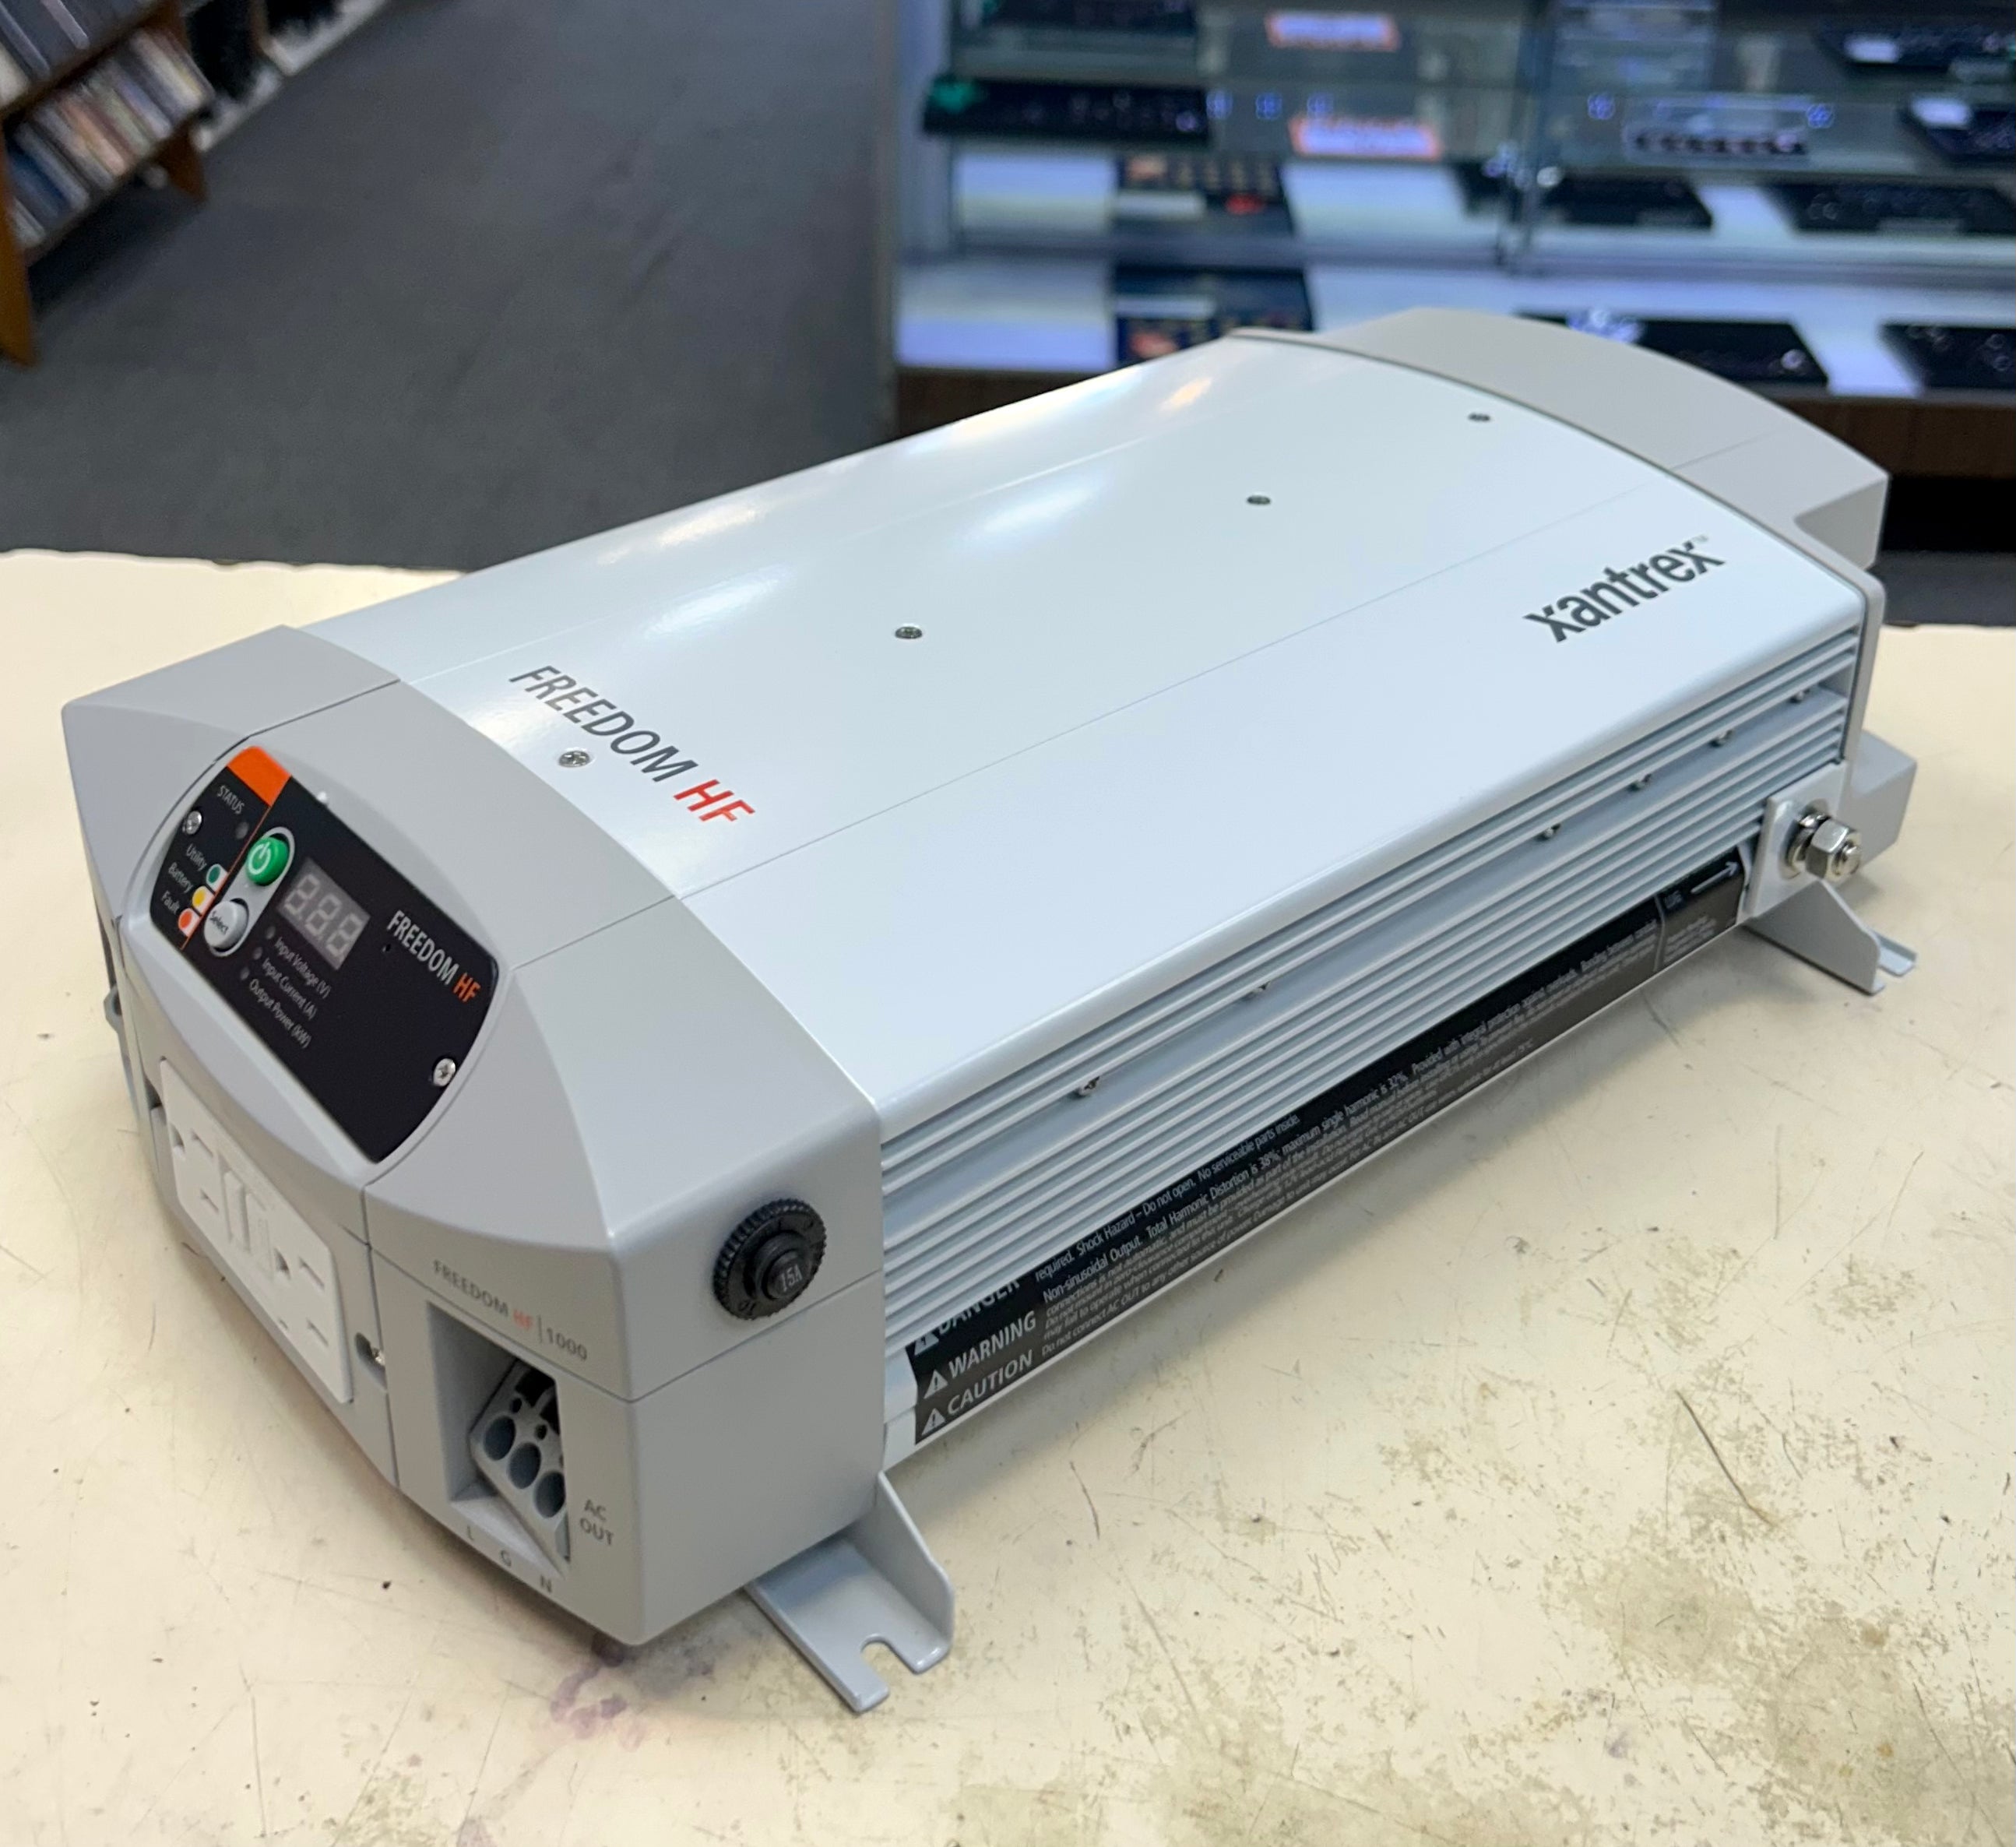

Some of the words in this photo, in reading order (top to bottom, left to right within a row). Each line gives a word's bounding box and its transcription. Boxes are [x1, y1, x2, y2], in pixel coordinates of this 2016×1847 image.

[1522, 540, 1726, 643] xantrex
[508, 665, 698, 783] FREEDOM
[672, 779, 755, 822] HF
[217, 785, 245, 814] STATUS
[167, 862, 194, 893] Battery
[186, 843, 207, 871] Utility
[160, 890, 181, 915] Fault
[209, 909, 229, 935] Select
[275, 937, 295, 962] Input
[293, 953, 319, 987] Voltage
[315, 980, 332, 1000] (V)
[386, 909, 460, 985] FREEDOM
[452, 972, 481, 1003] HF
[249, 978, 275, 1009] Output
[273, 1001, 294, 1031] Power
[262, 957, 282, 983] Input
[279, 975, 307, 1009] Current
[303, 1001, 318, 1022] (A)
[1043, 1252, 1107, 1303] Non-sinusoidal
[1110, 1233, 1142, 1263] Output.
[1146, 1216, 1167, 1240] Total
[1168, 1193, 1209, 1226] Harmonic
[1209, 1170, 1248, 1201] Distortion
[1250, 1163, 1258, 1177] is
[1282, 1125, 1321, 1157] maximum
[1076, 1229, 1103, 1257] Shock
[1104, 1210, 1135, 1240] Hazard
[1142, 1200, 1156, 1216] Do
[1157, 1187, 1171, 1208] not
[1198, 1167, 1211, 1183] No
[1212, 1140, 1254, 1174] serviceable
[1255, 1128, 1275, 1152] parts
[780, 1264, 804, 1293] 15A
[433, 1259, 509, 1318] FREEDOM
[512, 1308, 533, 1332] HF
[546, 1327, 588, 1361] 1000
[948, 1310, 1036, 1380] WARNING
[947, 1349, 1033, 1416] CAUTION
[579, 1518, 614, 1546] OUT
[584, 1499, 607, 1523] AC
[540, 1574, 553, 1594] N
